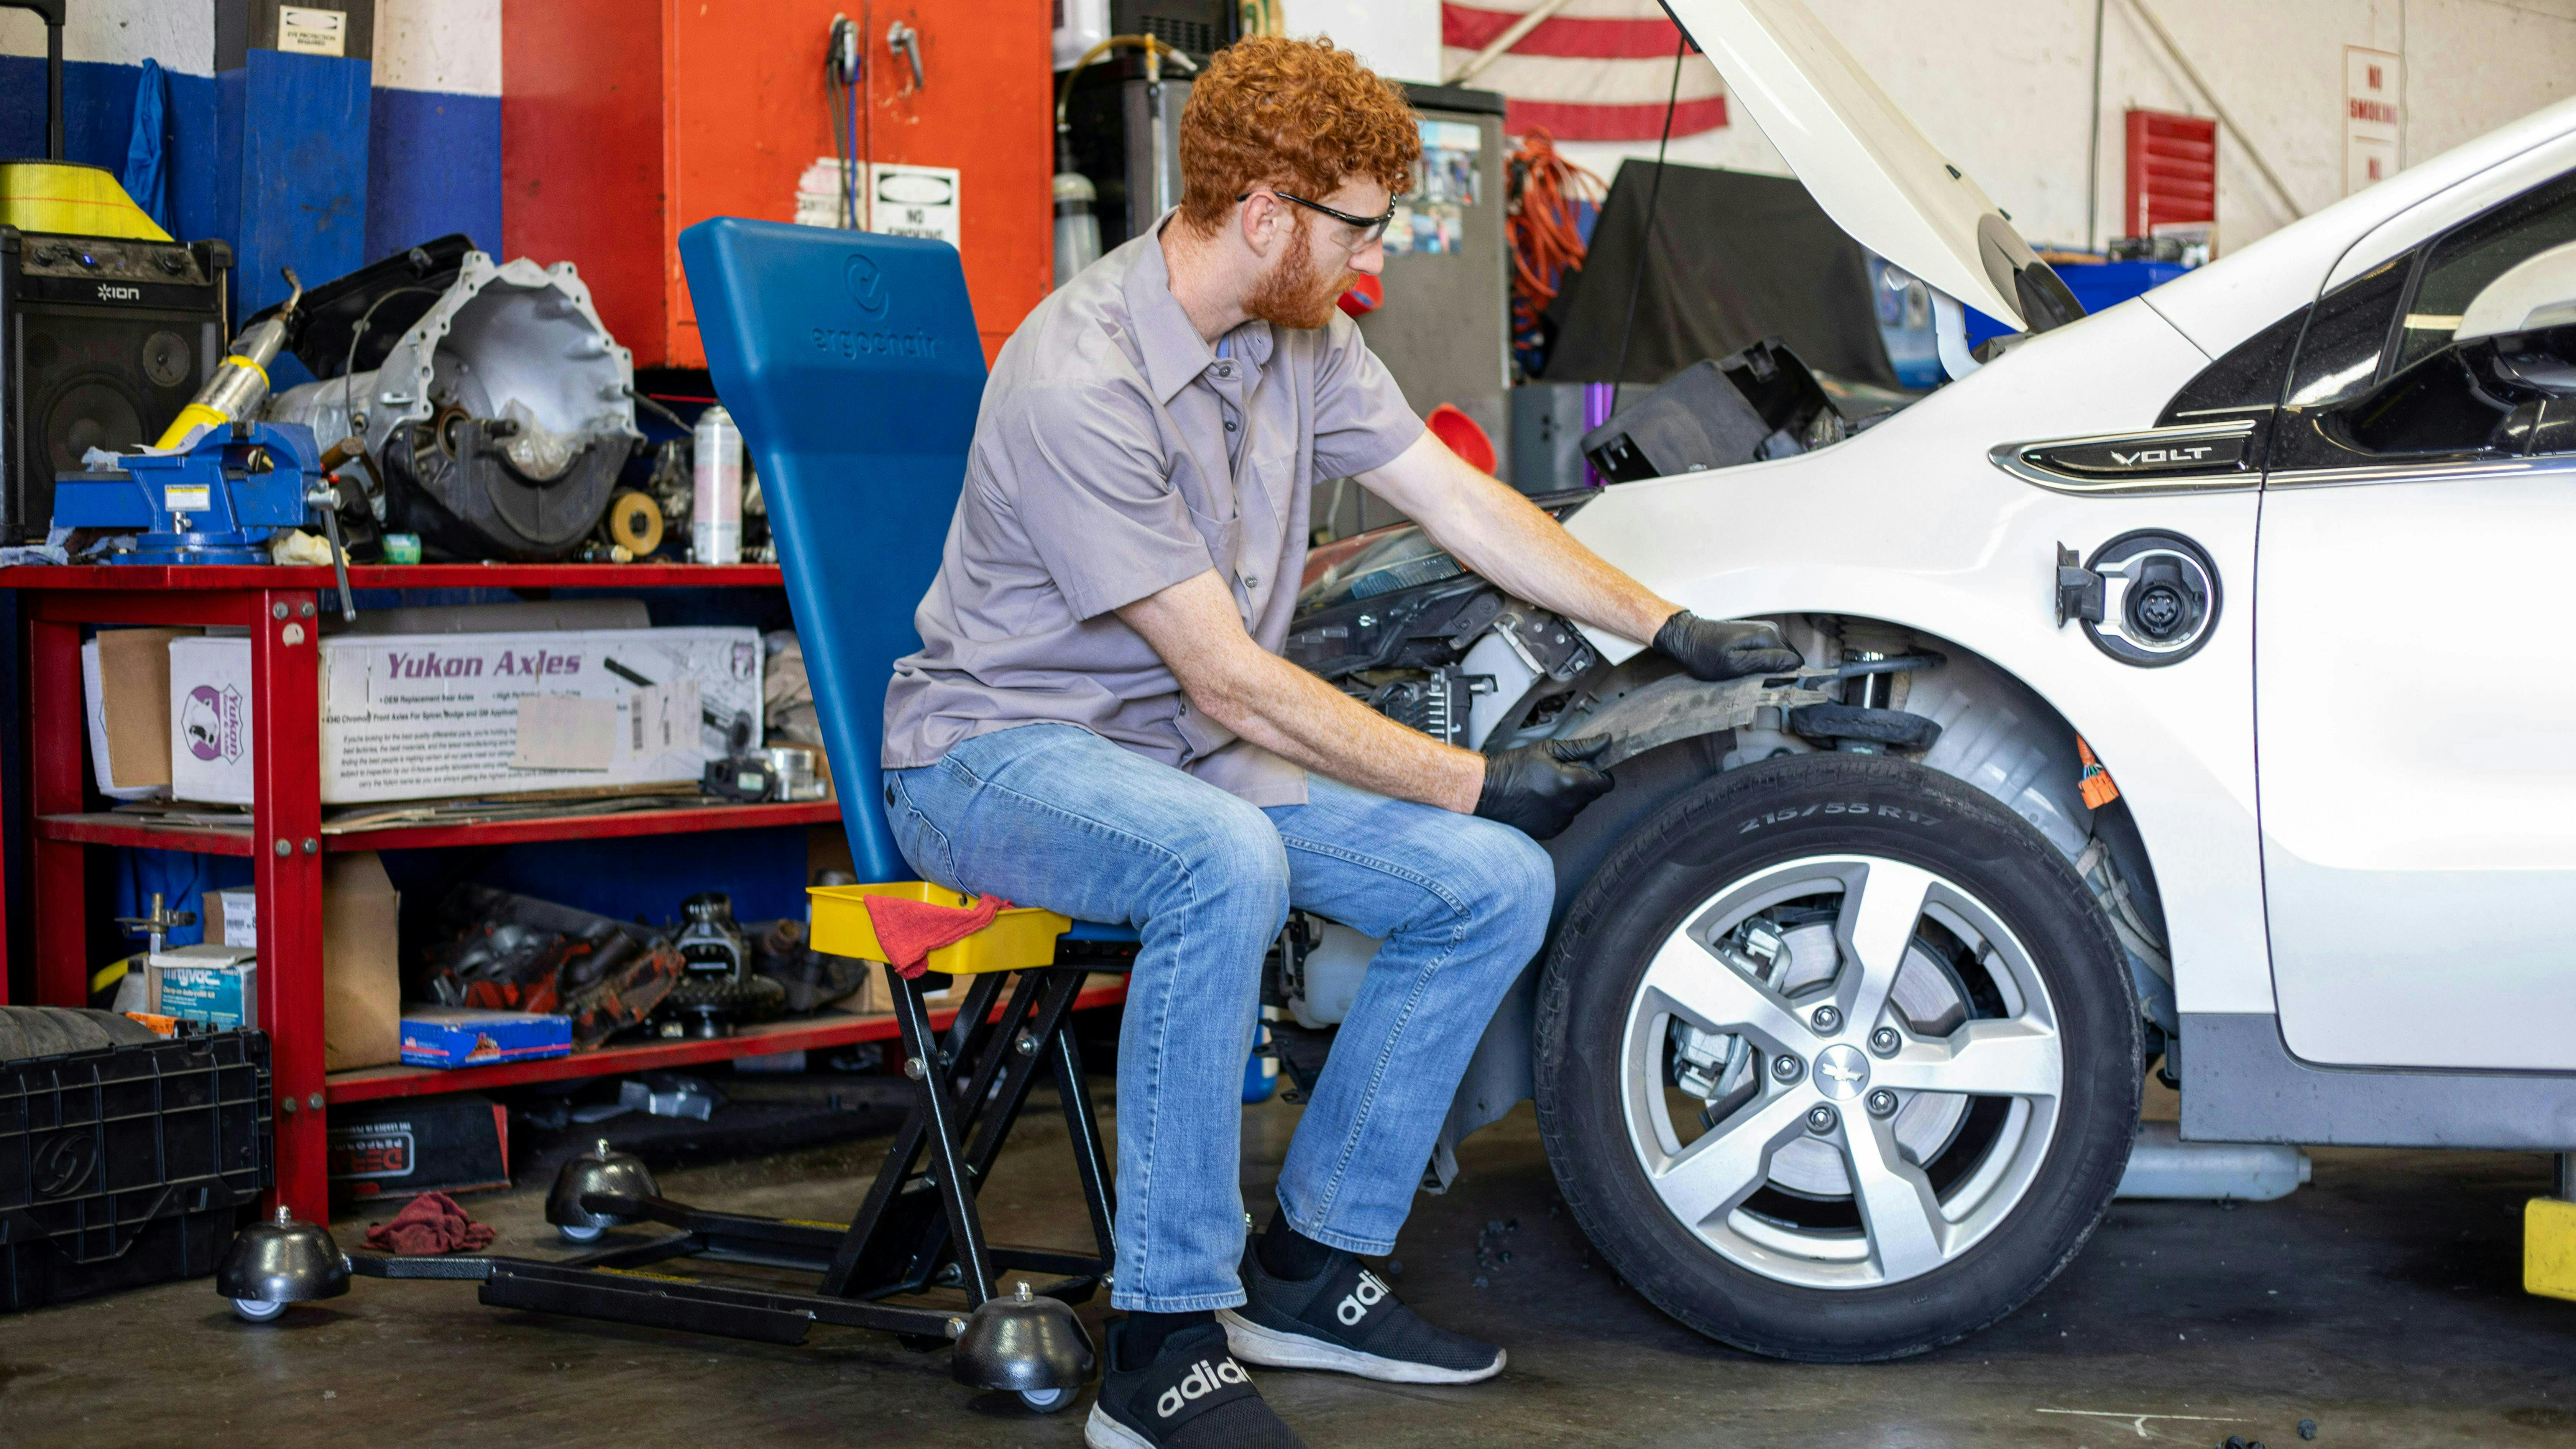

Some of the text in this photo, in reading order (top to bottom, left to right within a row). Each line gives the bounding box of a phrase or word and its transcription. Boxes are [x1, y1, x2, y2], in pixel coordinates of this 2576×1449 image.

[2368, 64, 2382, 91] NO
[2350, 98, 2397, 126] SMOKING
[907, 209, 923, 224] NO
[811, 326, 936, 360] ergochair
[2111, 446, 2212, 467] VOLT
[388, 650, 581, 679] Yukon Axles
[384, 695, 398, 704] OEM
[401, 695, 440, 705] Replacement
[229, 695, 238, 756] Yukon
[373, 713, 389, 721] Front
[1738, 802, 1943, 834] 215/55 R17
[334, 1137, 402, 1150] PERFORM
[1337, 1269, 1392, 1326] adi
[1157, 1356, 1254, 1418] adid
